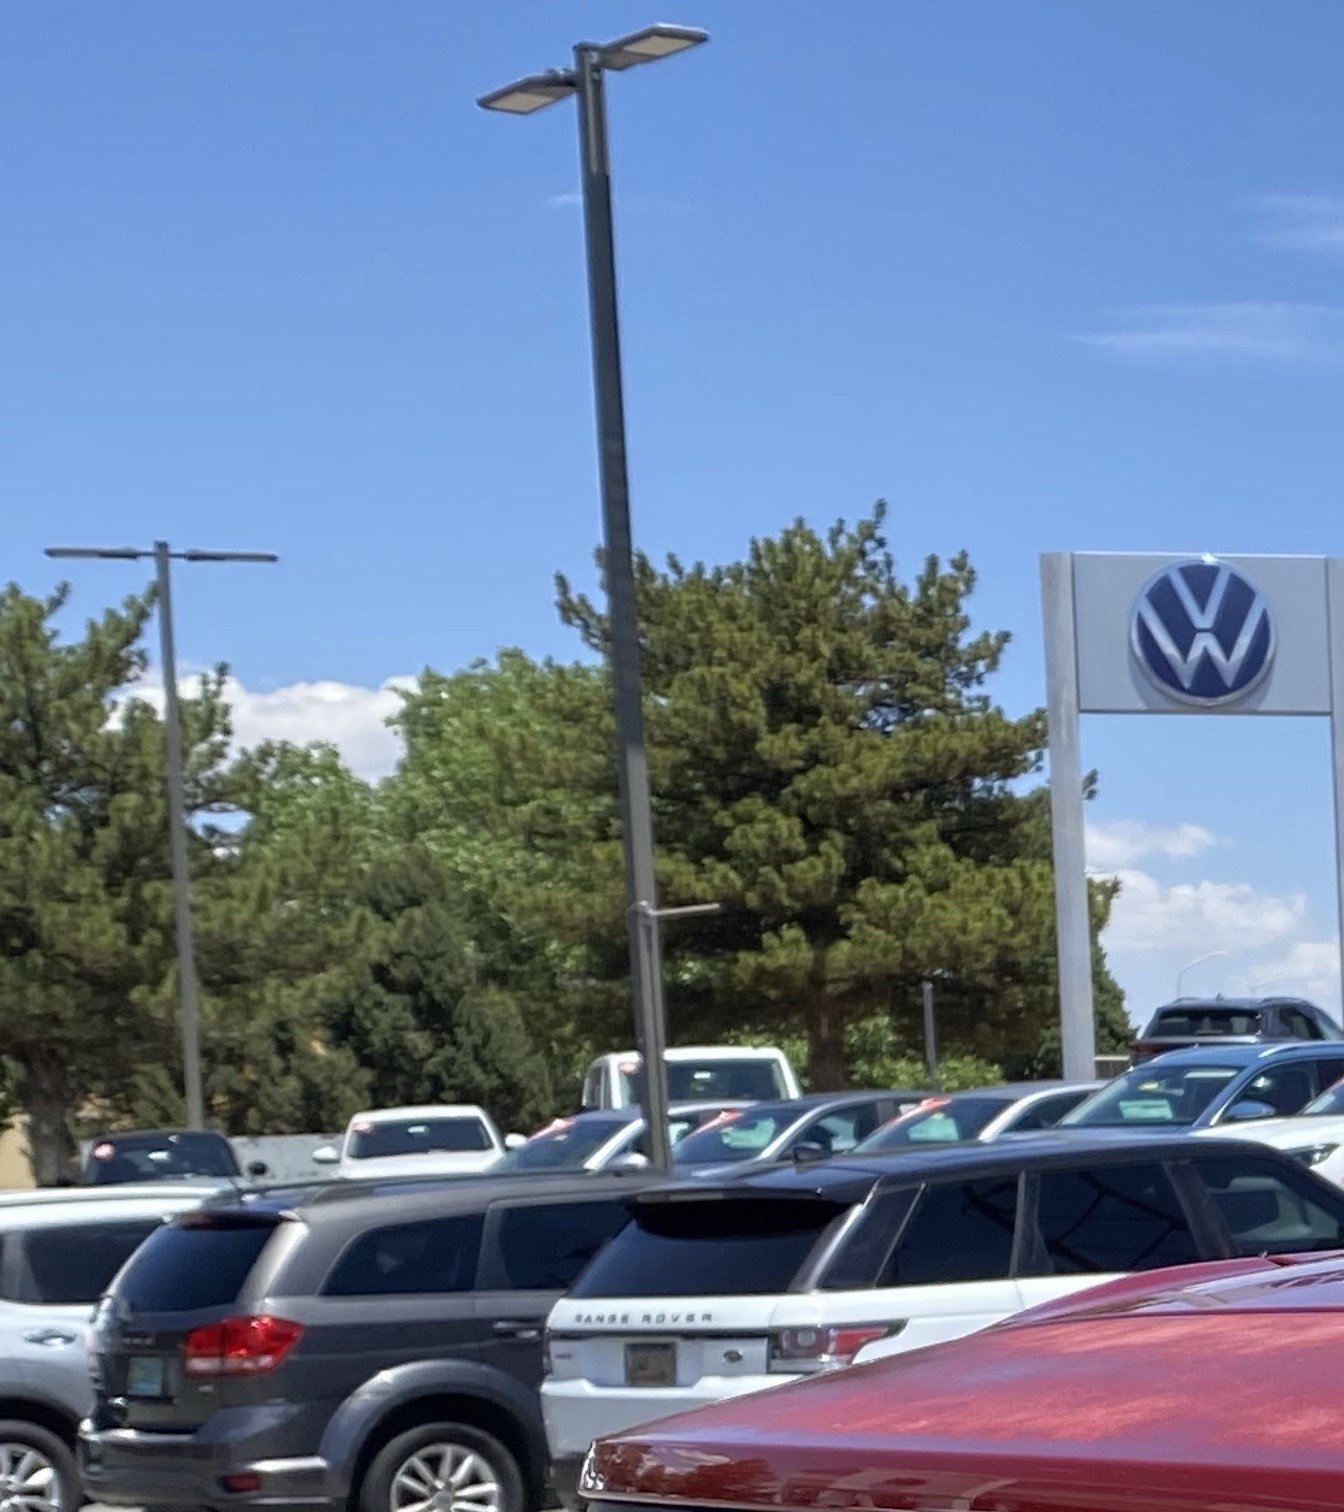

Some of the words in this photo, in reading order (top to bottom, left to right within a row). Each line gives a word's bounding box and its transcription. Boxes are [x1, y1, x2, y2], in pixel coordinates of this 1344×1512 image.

[1135, 561, 1269, 690] VW
[574, 1313, 629, 1324] RANGE
[641, 1313, 712, 1324] ROVER
